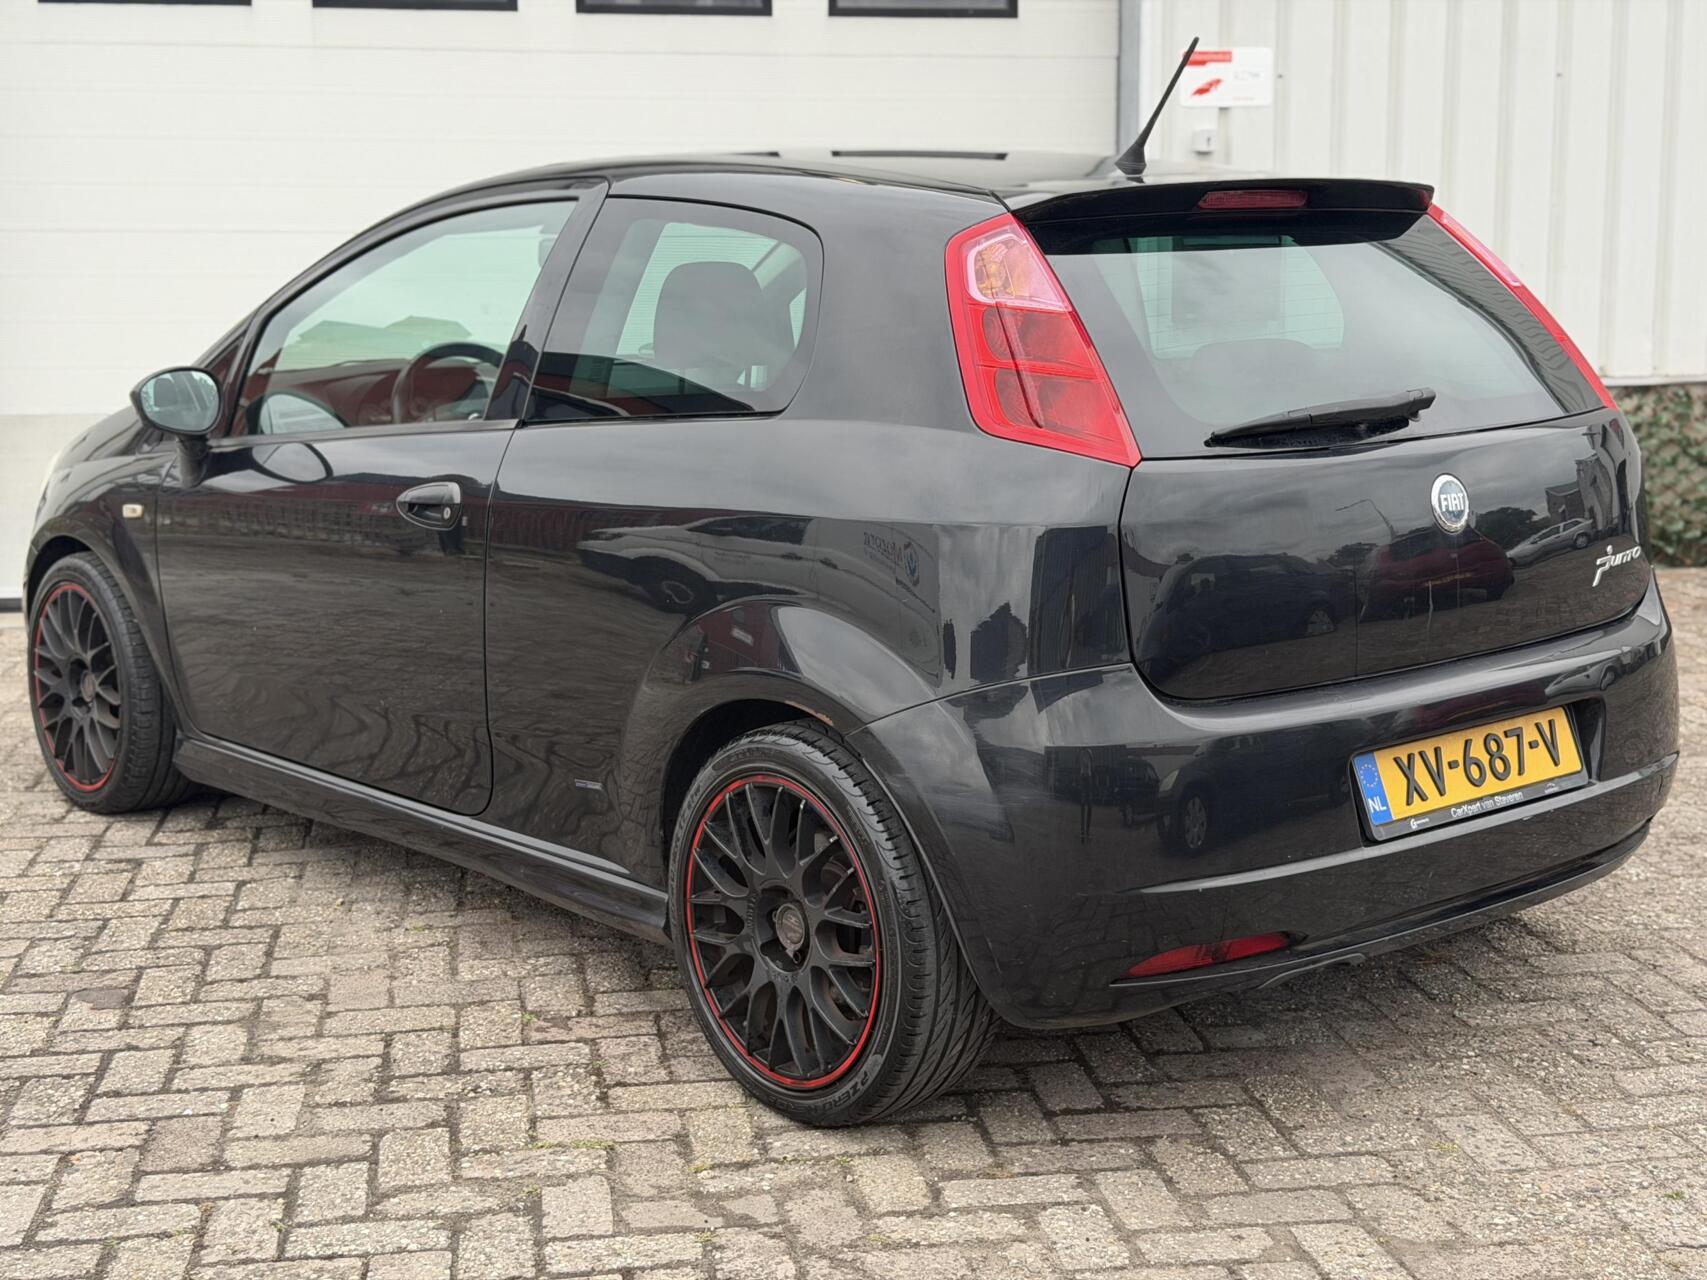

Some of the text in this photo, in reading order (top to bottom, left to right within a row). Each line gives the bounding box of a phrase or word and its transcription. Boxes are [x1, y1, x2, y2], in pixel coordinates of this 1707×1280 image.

[1440, 494, 1464, 512] FIAT
[1393, 718, 1561, 806] XV-687-V
[1368, 796, 1387, 814] NL
